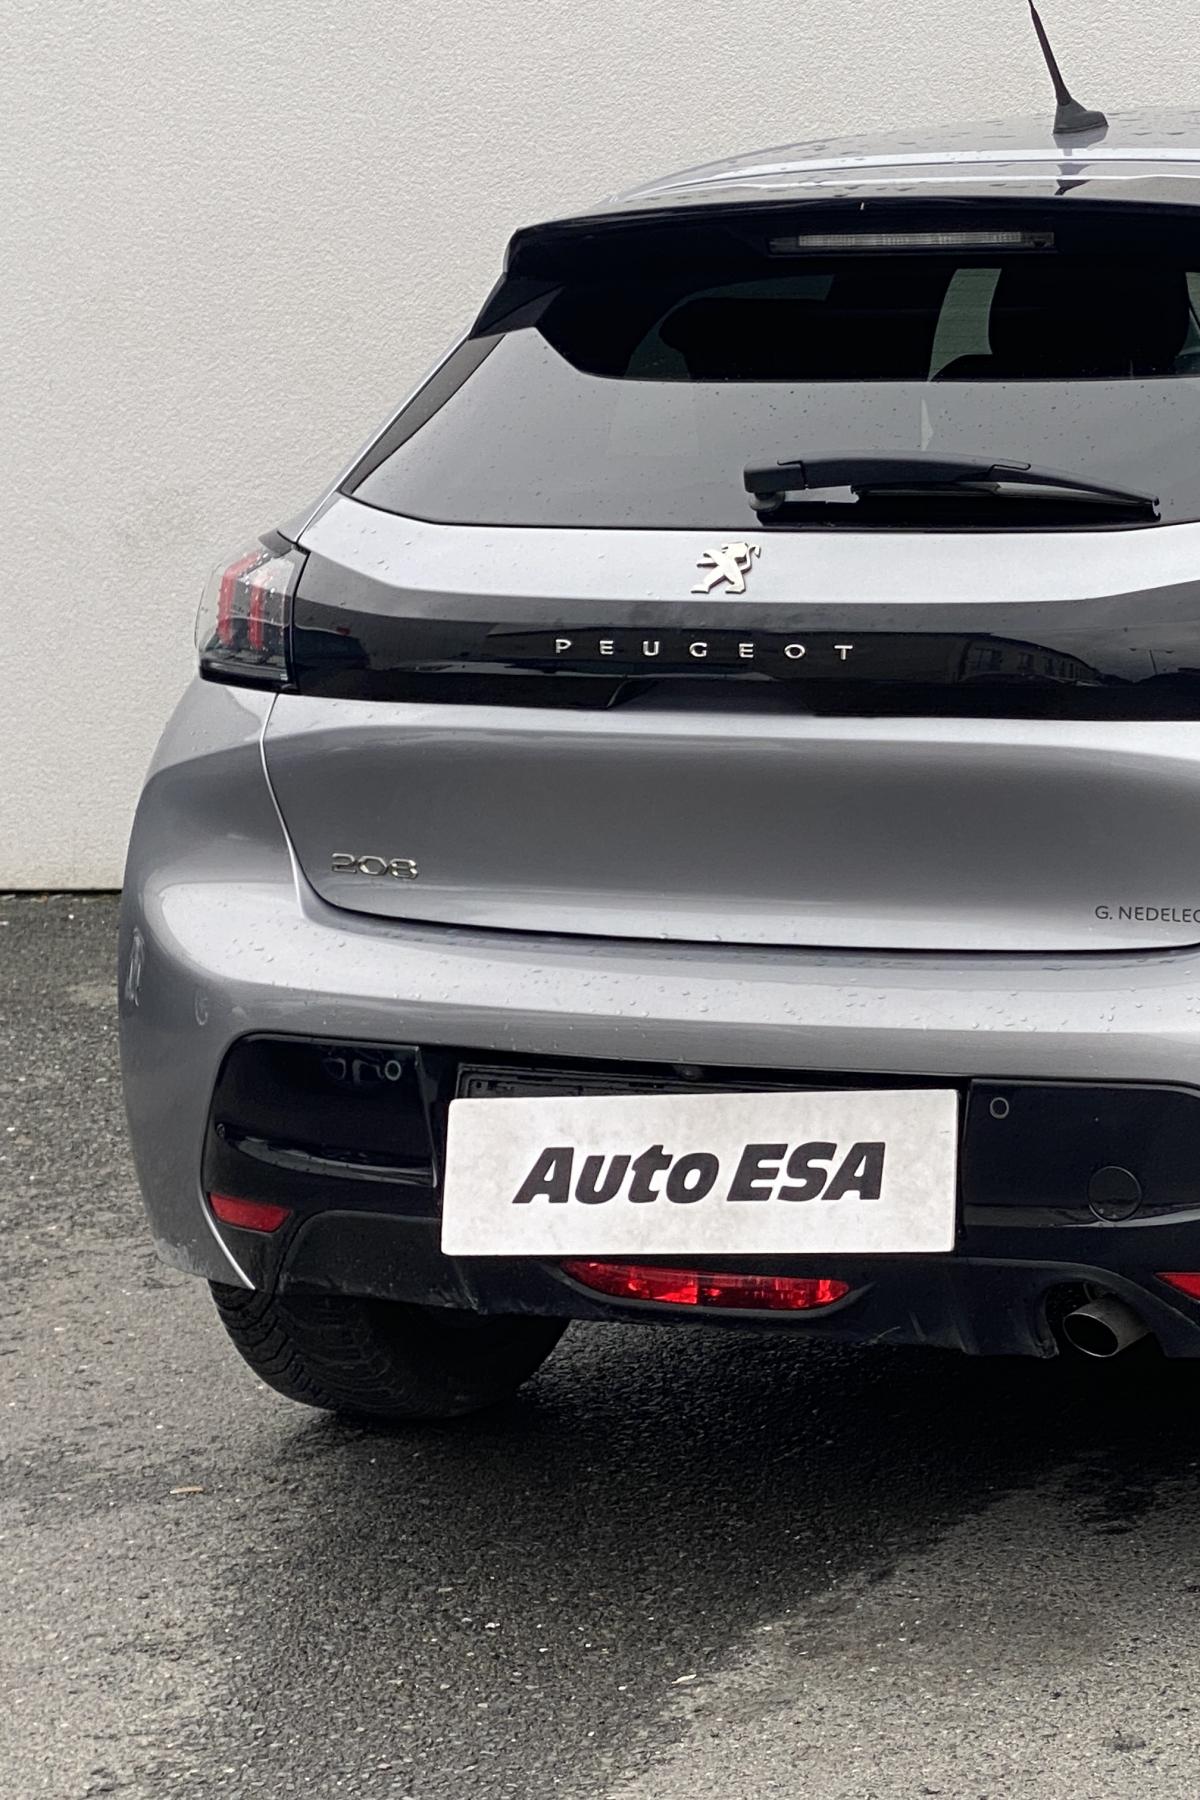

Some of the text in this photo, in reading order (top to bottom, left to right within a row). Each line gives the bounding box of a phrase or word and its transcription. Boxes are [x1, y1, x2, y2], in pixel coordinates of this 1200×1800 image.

[555, 638, 854, 661] PEUGEOT
[331, 853, 419, 879] 208
[1095, 905, 1113, 920] G.
[512, 1141, 886, 1204] Auto ESA
